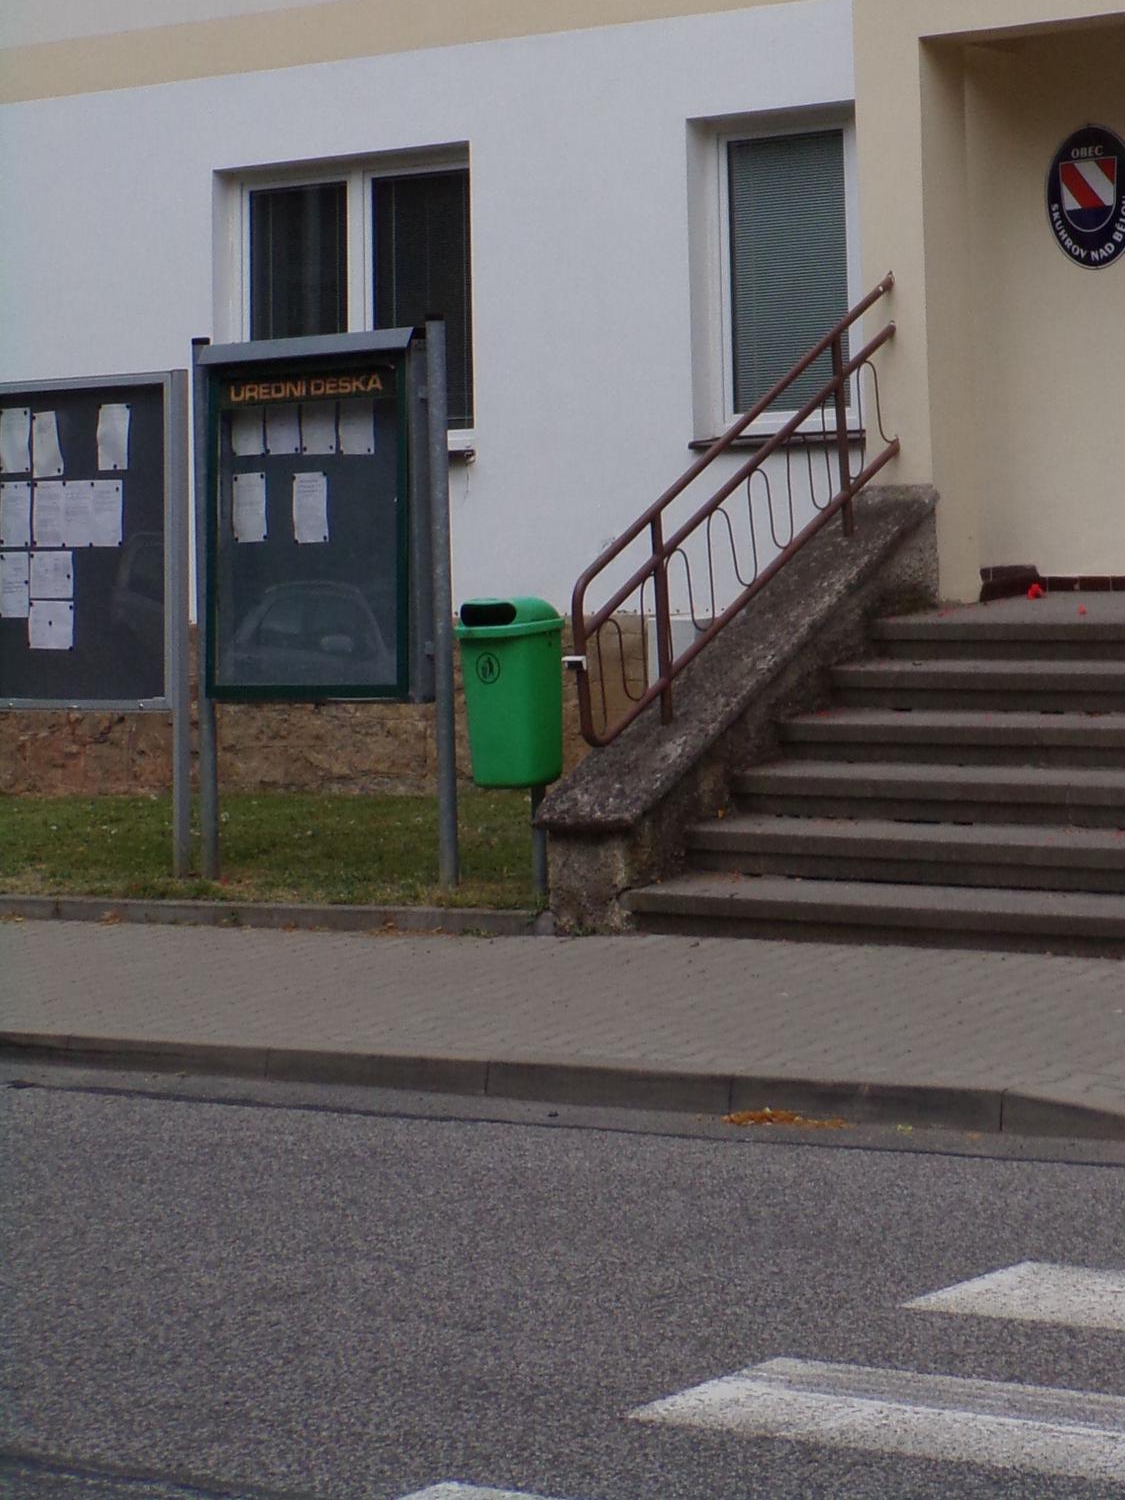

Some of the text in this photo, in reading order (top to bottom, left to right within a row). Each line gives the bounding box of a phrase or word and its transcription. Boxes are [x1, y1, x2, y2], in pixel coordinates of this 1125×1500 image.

[1070, 144, 1104, 159] OBEC
[1050, 203, 1088, 260] SKUHROV
[1090, 242, 1115, 262] NAD
[309, 372, 384, 396] DESKA
